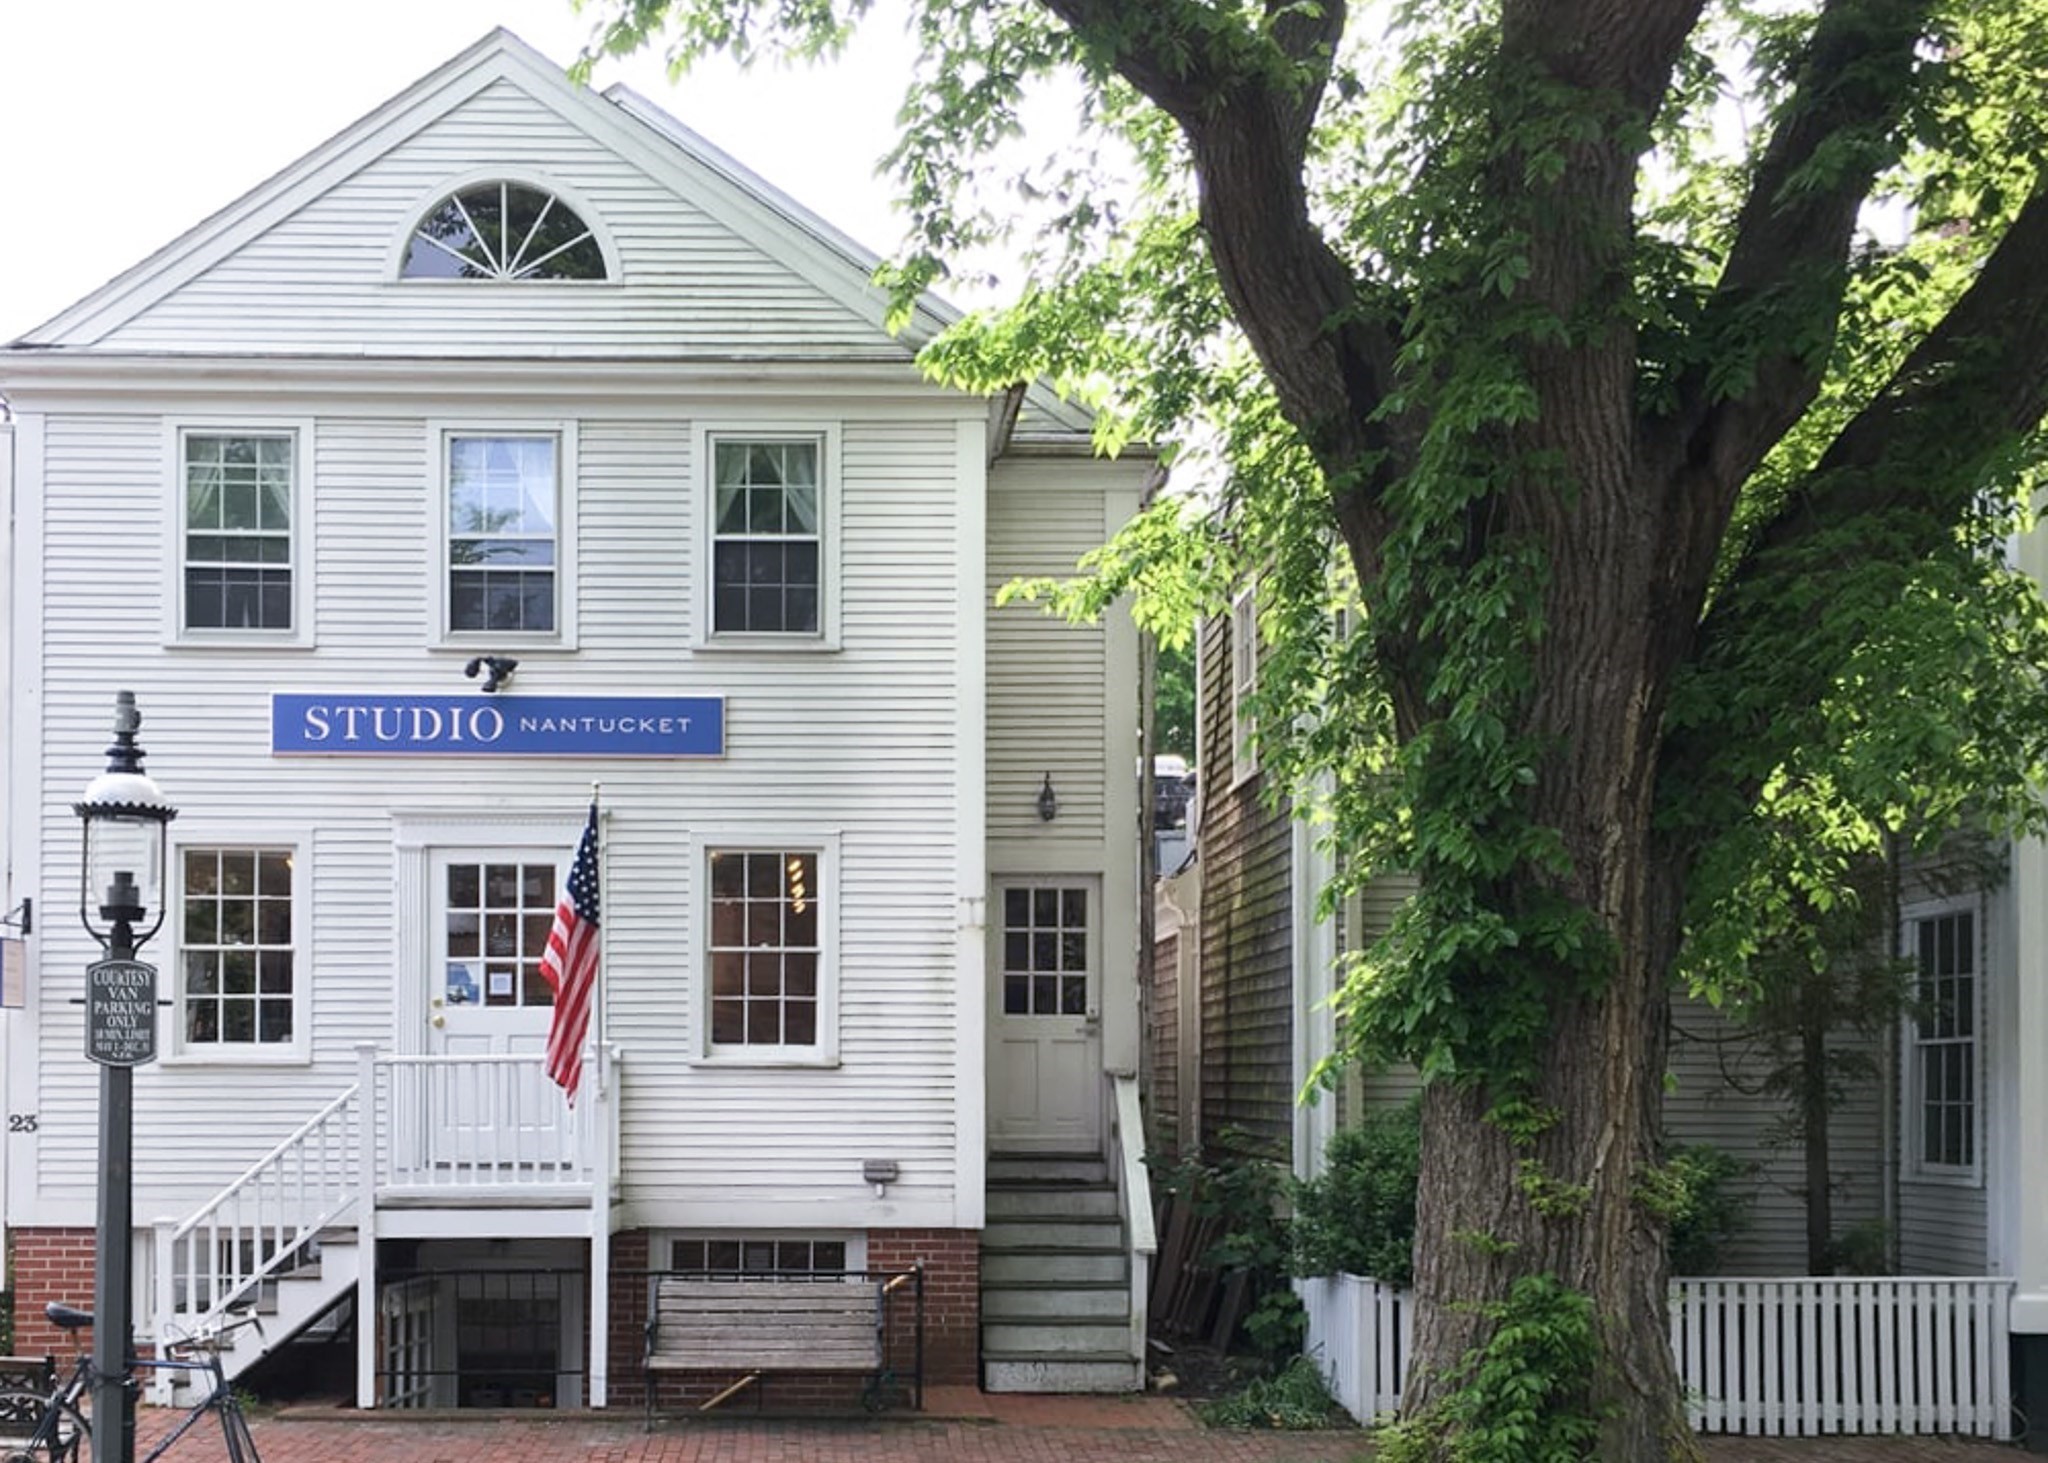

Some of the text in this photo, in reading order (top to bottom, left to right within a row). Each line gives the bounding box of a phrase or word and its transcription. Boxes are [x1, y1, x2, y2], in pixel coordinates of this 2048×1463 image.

[304, 706, 692, 742] STUDIO NANTUCKET
[93, 969, 151, 987] COURTESY
[107, 986, 138, 1000] VAN
[94, 1001, 151, 1015] PARKING
[106, 1015, 137, 1028] ONLY
[9, 1114, 38, 1134] 23
